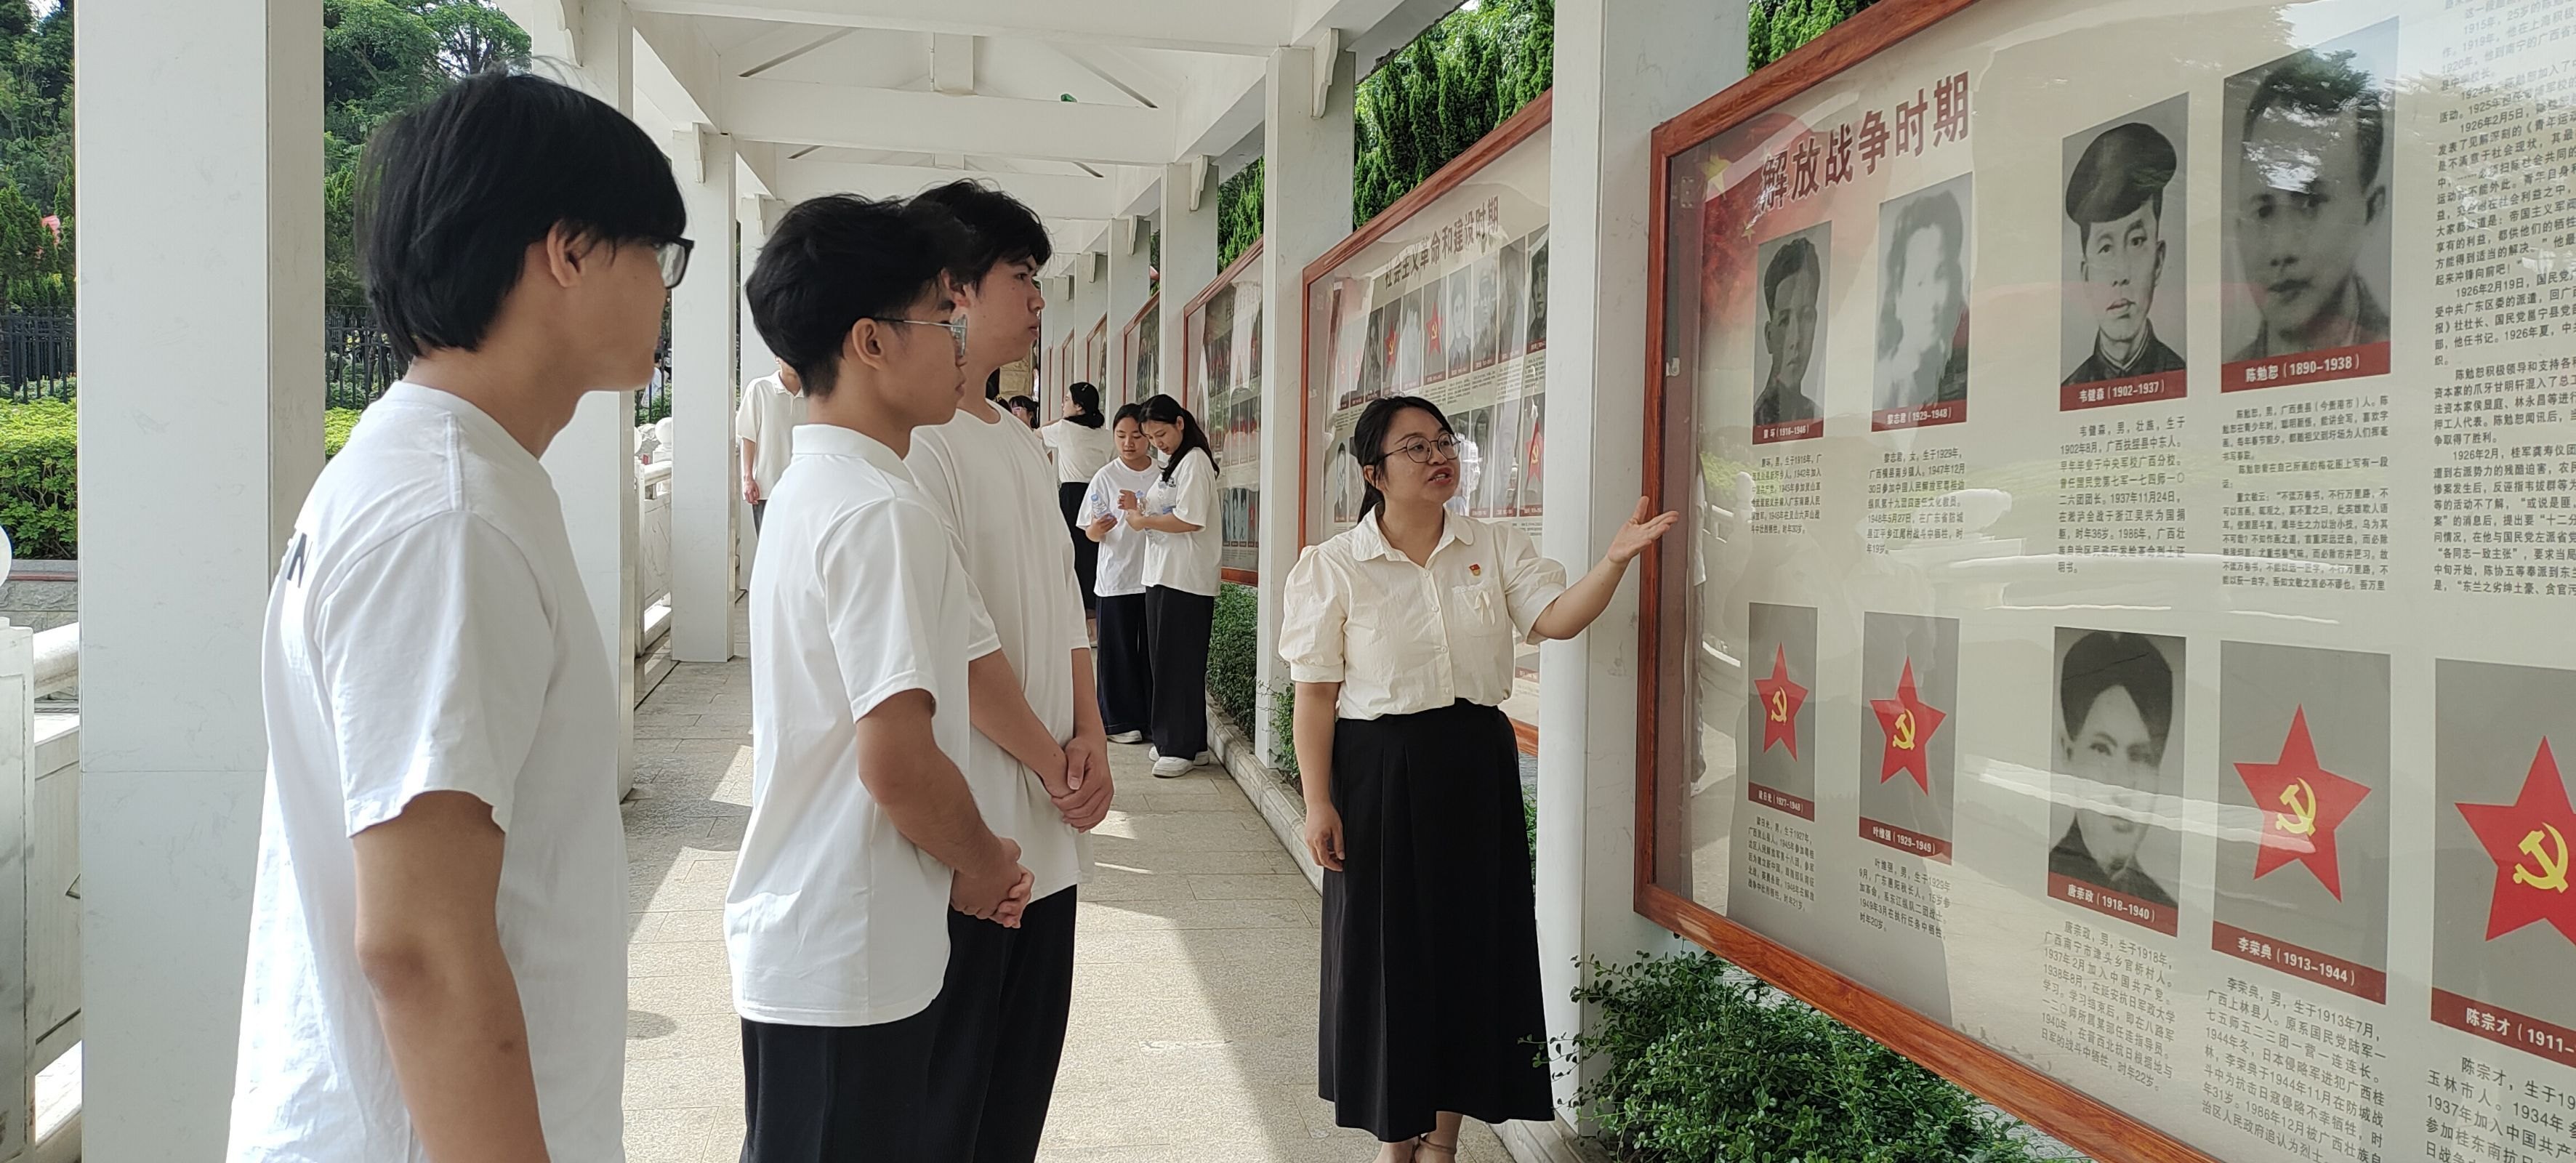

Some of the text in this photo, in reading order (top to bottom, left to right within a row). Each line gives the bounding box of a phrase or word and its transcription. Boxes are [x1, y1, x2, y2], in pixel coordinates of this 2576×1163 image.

[1761, 71, 1968, 212] 解放战争时期
[1385, 196, 1499, 289] 社会主义革命和建设时期
[2079, 379, 2165, 403] 韦健森（1902-1937）
[2245, 353, 2359, 383] 陈勉恕（1890-1938）
[2434, 432, 2497, 447] 争取得了胜利。
[1873, 826, 1936, 856] 叶维强（1929-1949）
[2068, 884, 2156, 923] 唐荣政（1918-1940）
[2237, 936, 2355, 986] 李荣典（1913-1944）
[2207, 989, 2386, 1060] 广西上林县人。原系国民党陆军一
[2226, 976, 2380, 1042] 李荣典，男，生于1913年7月，
[2466, 1007, 2576, 1053] 陈宗才（1911-
[2205, 1027, 2385, 1107] 1944年冬，日本侵略军进犯广西桂
[2206, 1007, 2379, 1084] 七五师五二三团一营一连连长。
[2203, 1063, 2383, 1148] 斗中为抗击日寇侵略不幸牺牲，时
[2205, 1045, 2384, 1128] 林，李荣典于1944年11月在防城战
[2426, 1140, 2477, 1163] 日战争
[2427, 1094, 2576, 1161] 1937年加入中国共产
